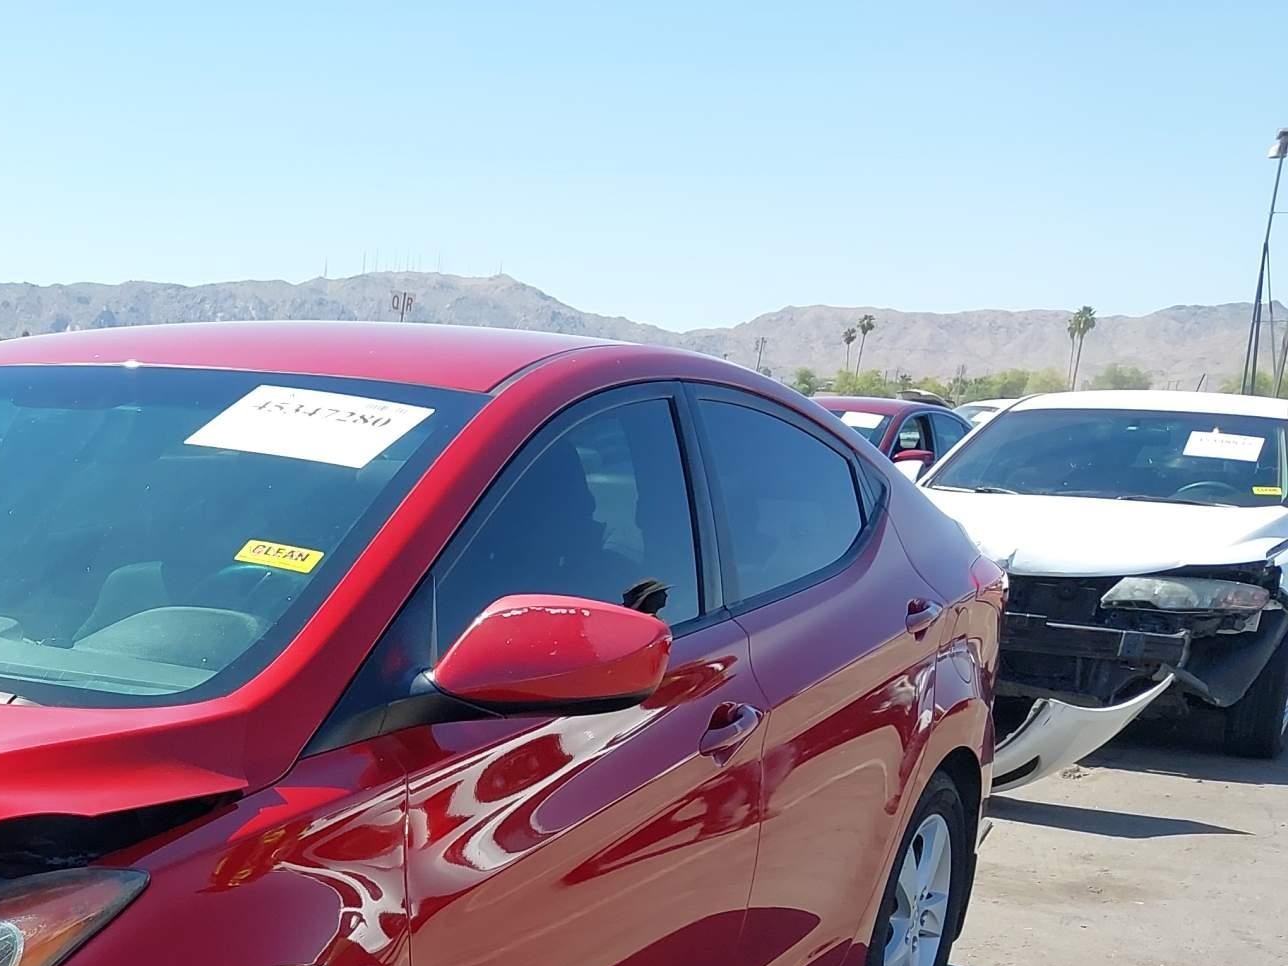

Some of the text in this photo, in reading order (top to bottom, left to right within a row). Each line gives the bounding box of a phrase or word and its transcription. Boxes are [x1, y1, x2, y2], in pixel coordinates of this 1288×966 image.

[406, 297, 413, 312] R
[252, 400, 392, 428] 45347280
[252, 544, 310, 562] CLEAN
